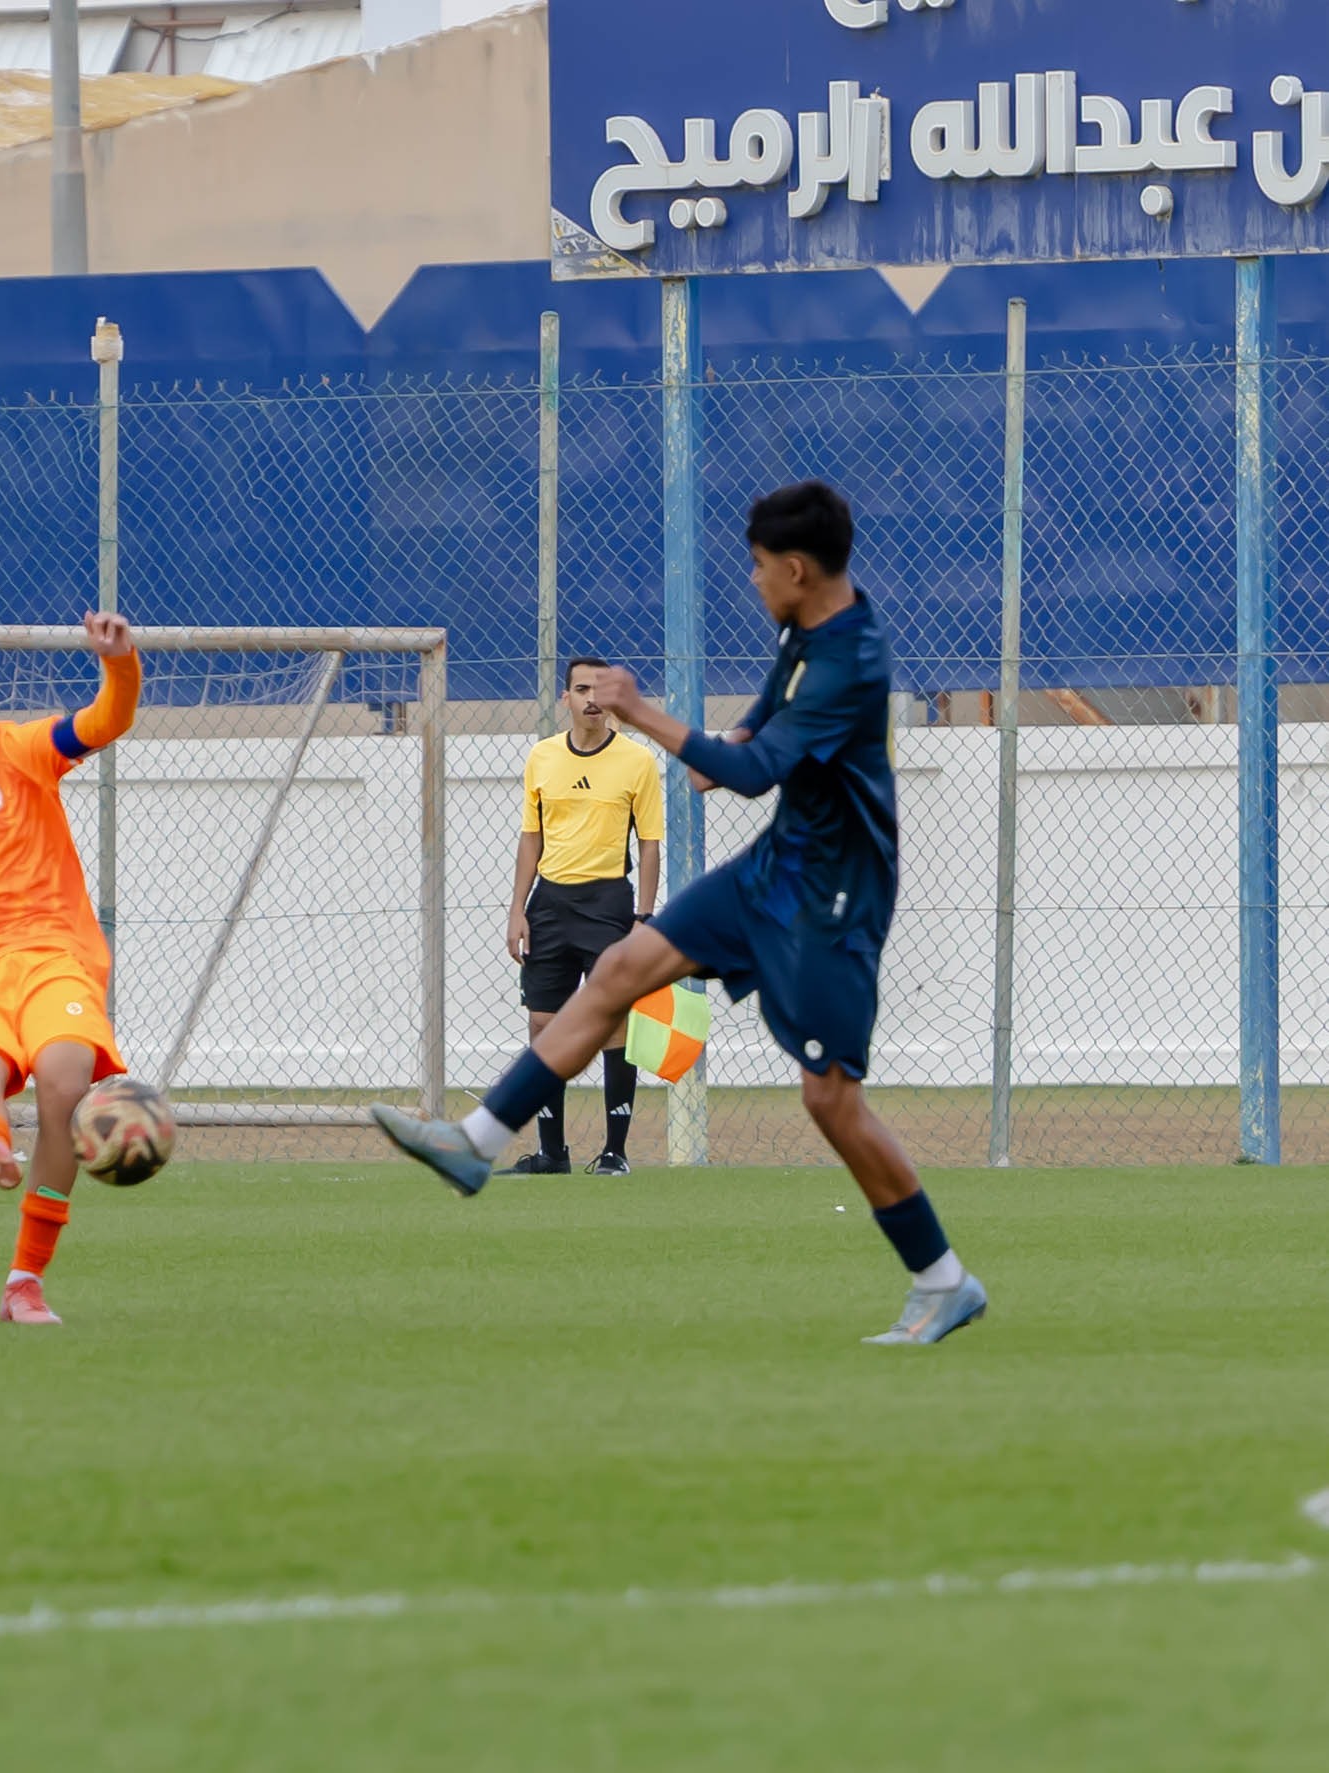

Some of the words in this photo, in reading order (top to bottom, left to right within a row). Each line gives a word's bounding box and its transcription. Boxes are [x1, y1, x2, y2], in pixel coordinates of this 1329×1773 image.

[590, 81, 891, 251] الرميح
[910, 70, 1237, 217] عبدالله
[1252, 75, 1329, 205] ن
